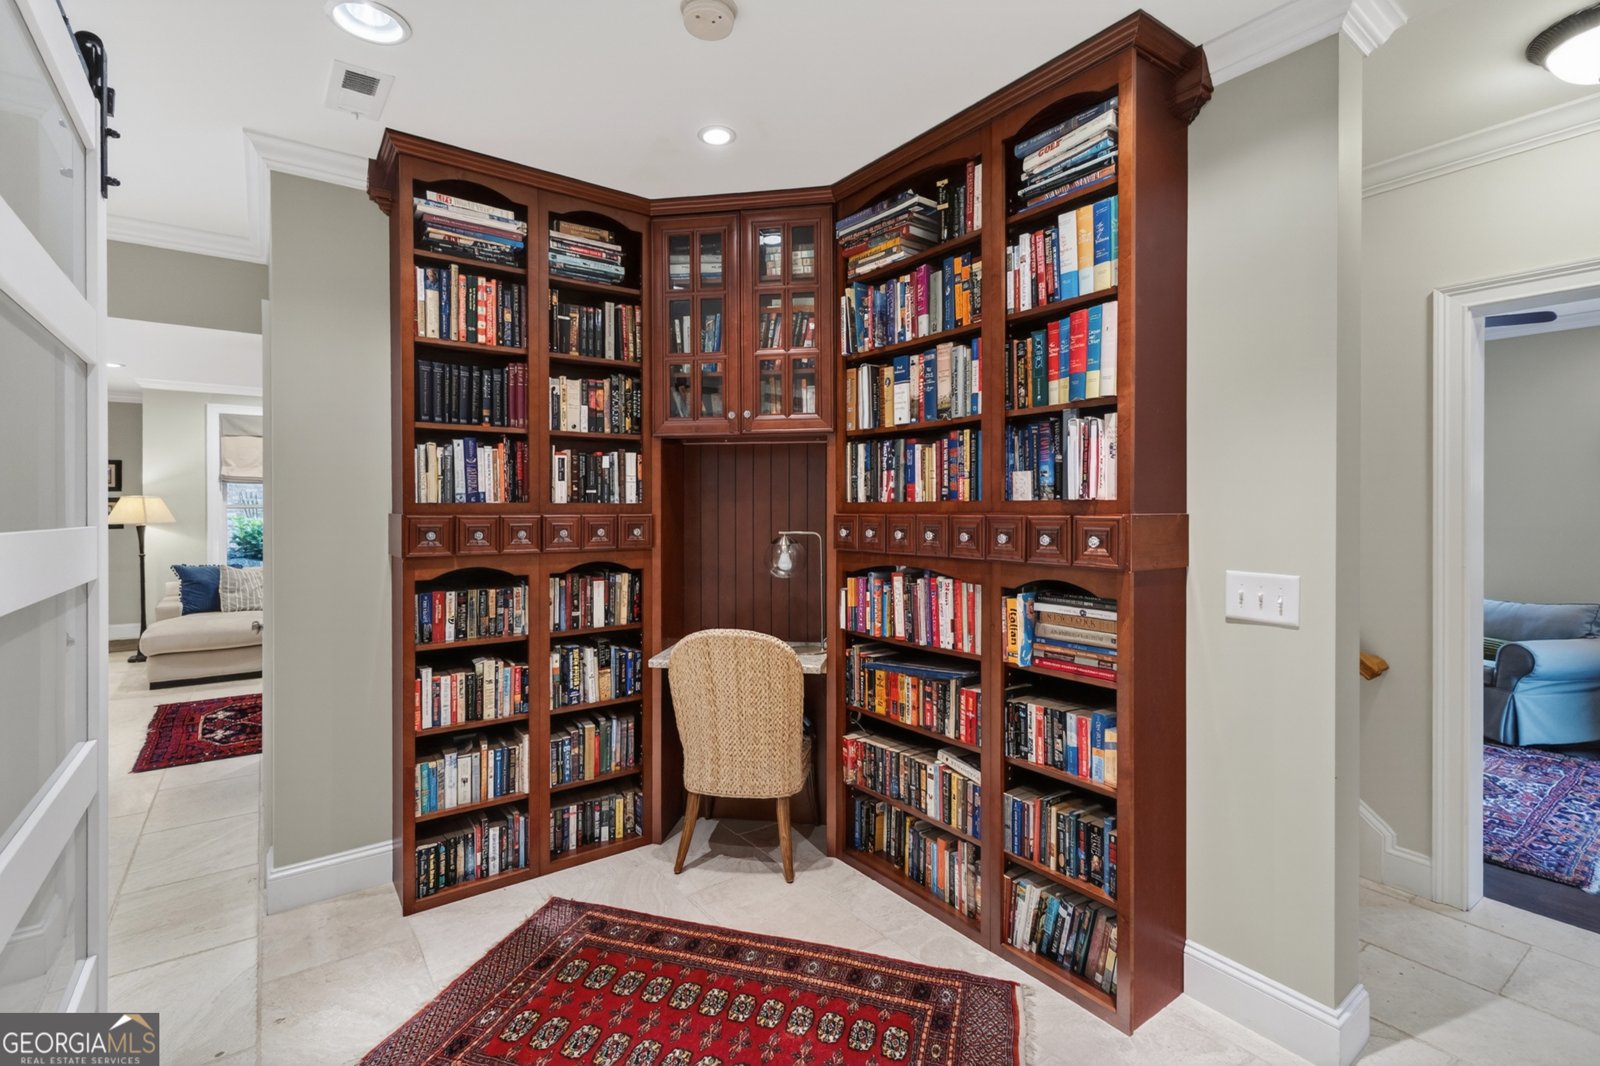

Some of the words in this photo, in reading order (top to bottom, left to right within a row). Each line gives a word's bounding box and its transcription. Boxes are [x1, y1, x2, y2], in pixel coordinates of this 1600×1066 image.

[1038, 139, 1063, 157] GOLF
[1046, 613, 1065, 622] NEW
[1070, 617, 1097, 628] YORK
